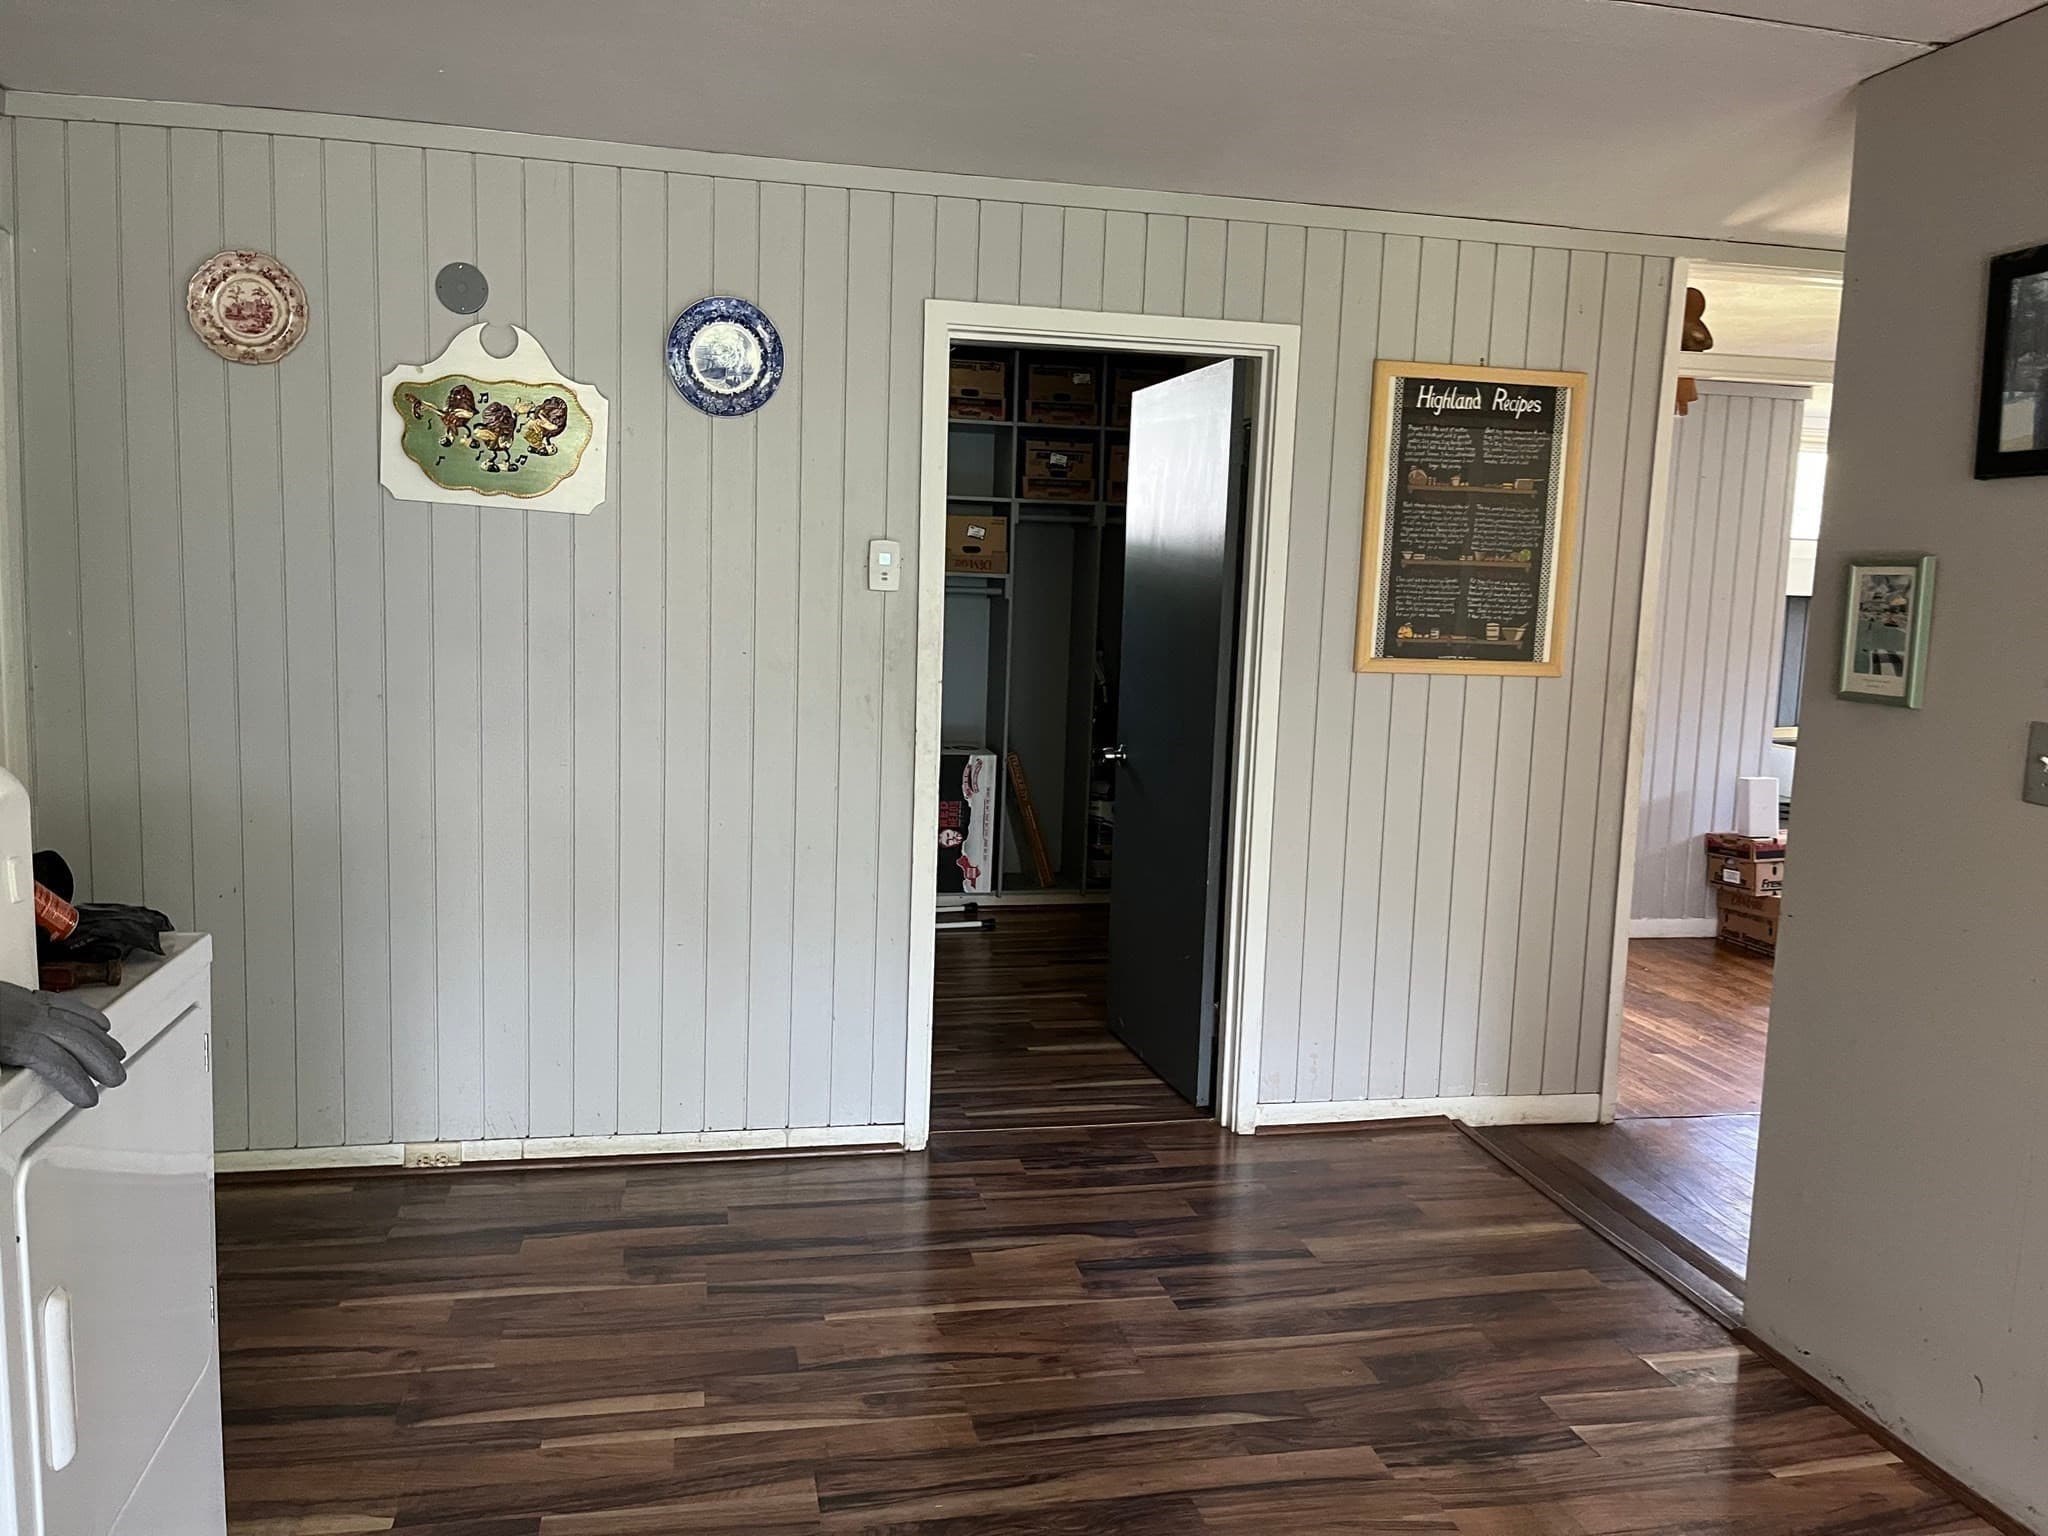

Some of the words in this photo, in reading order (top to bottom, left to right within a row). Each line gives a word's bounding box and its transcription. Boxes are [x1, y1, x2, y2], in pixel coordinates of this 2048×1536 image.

[1416, 385, 1482, 416] Highland
[1492, 387, 1542, 420] Recipes
[1761, 878, 1783, 888] Fres
